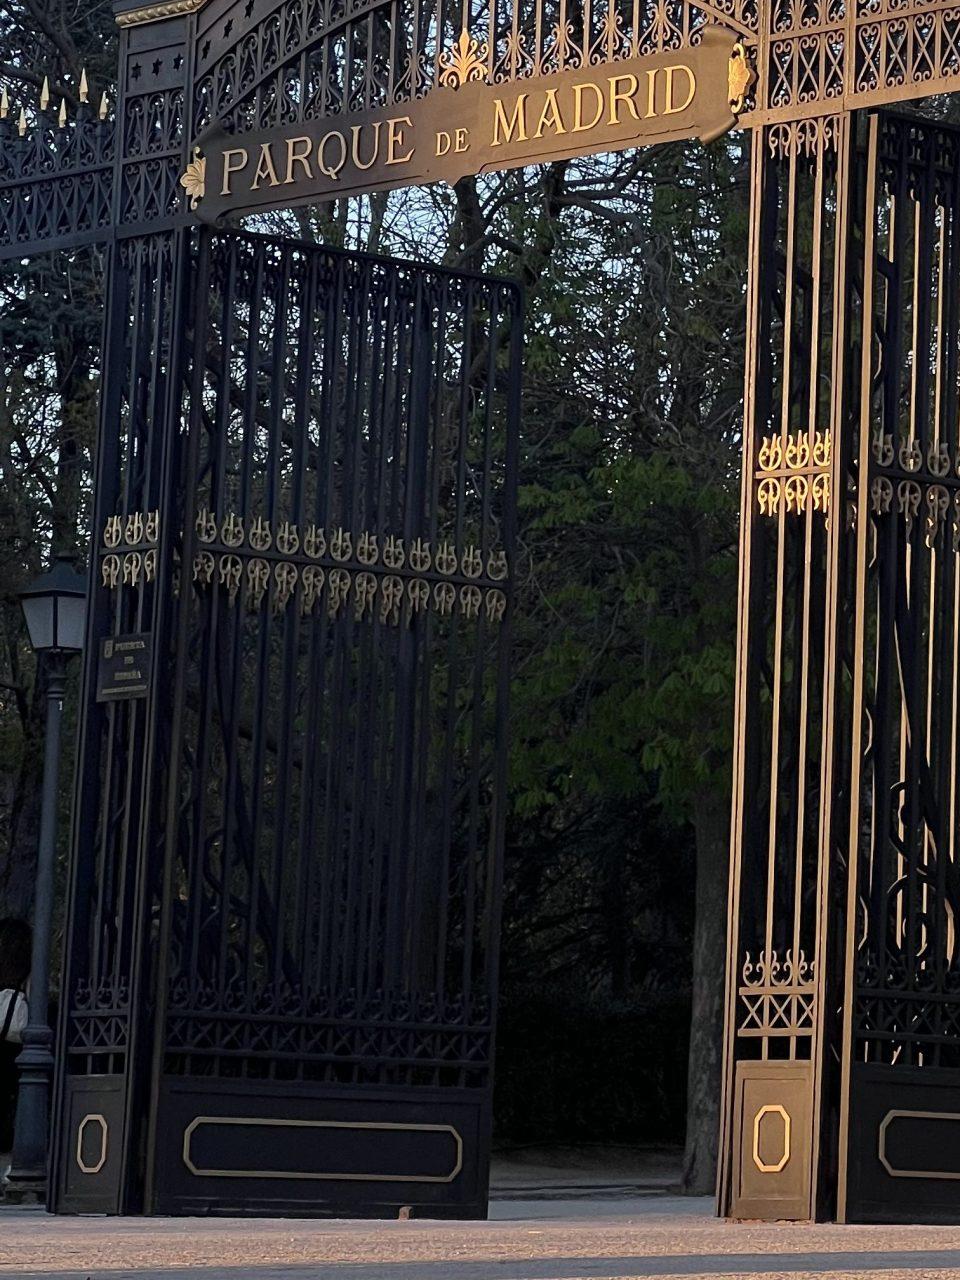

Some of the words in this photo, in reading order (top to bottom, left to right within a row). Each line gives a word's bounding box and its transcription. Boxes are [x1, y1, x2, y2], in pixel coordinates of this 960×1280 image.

[220, 116, 415, 196] PARQUE
[435, 128, 470, 157] DE
[490, 65, 697, 147] MADRID
